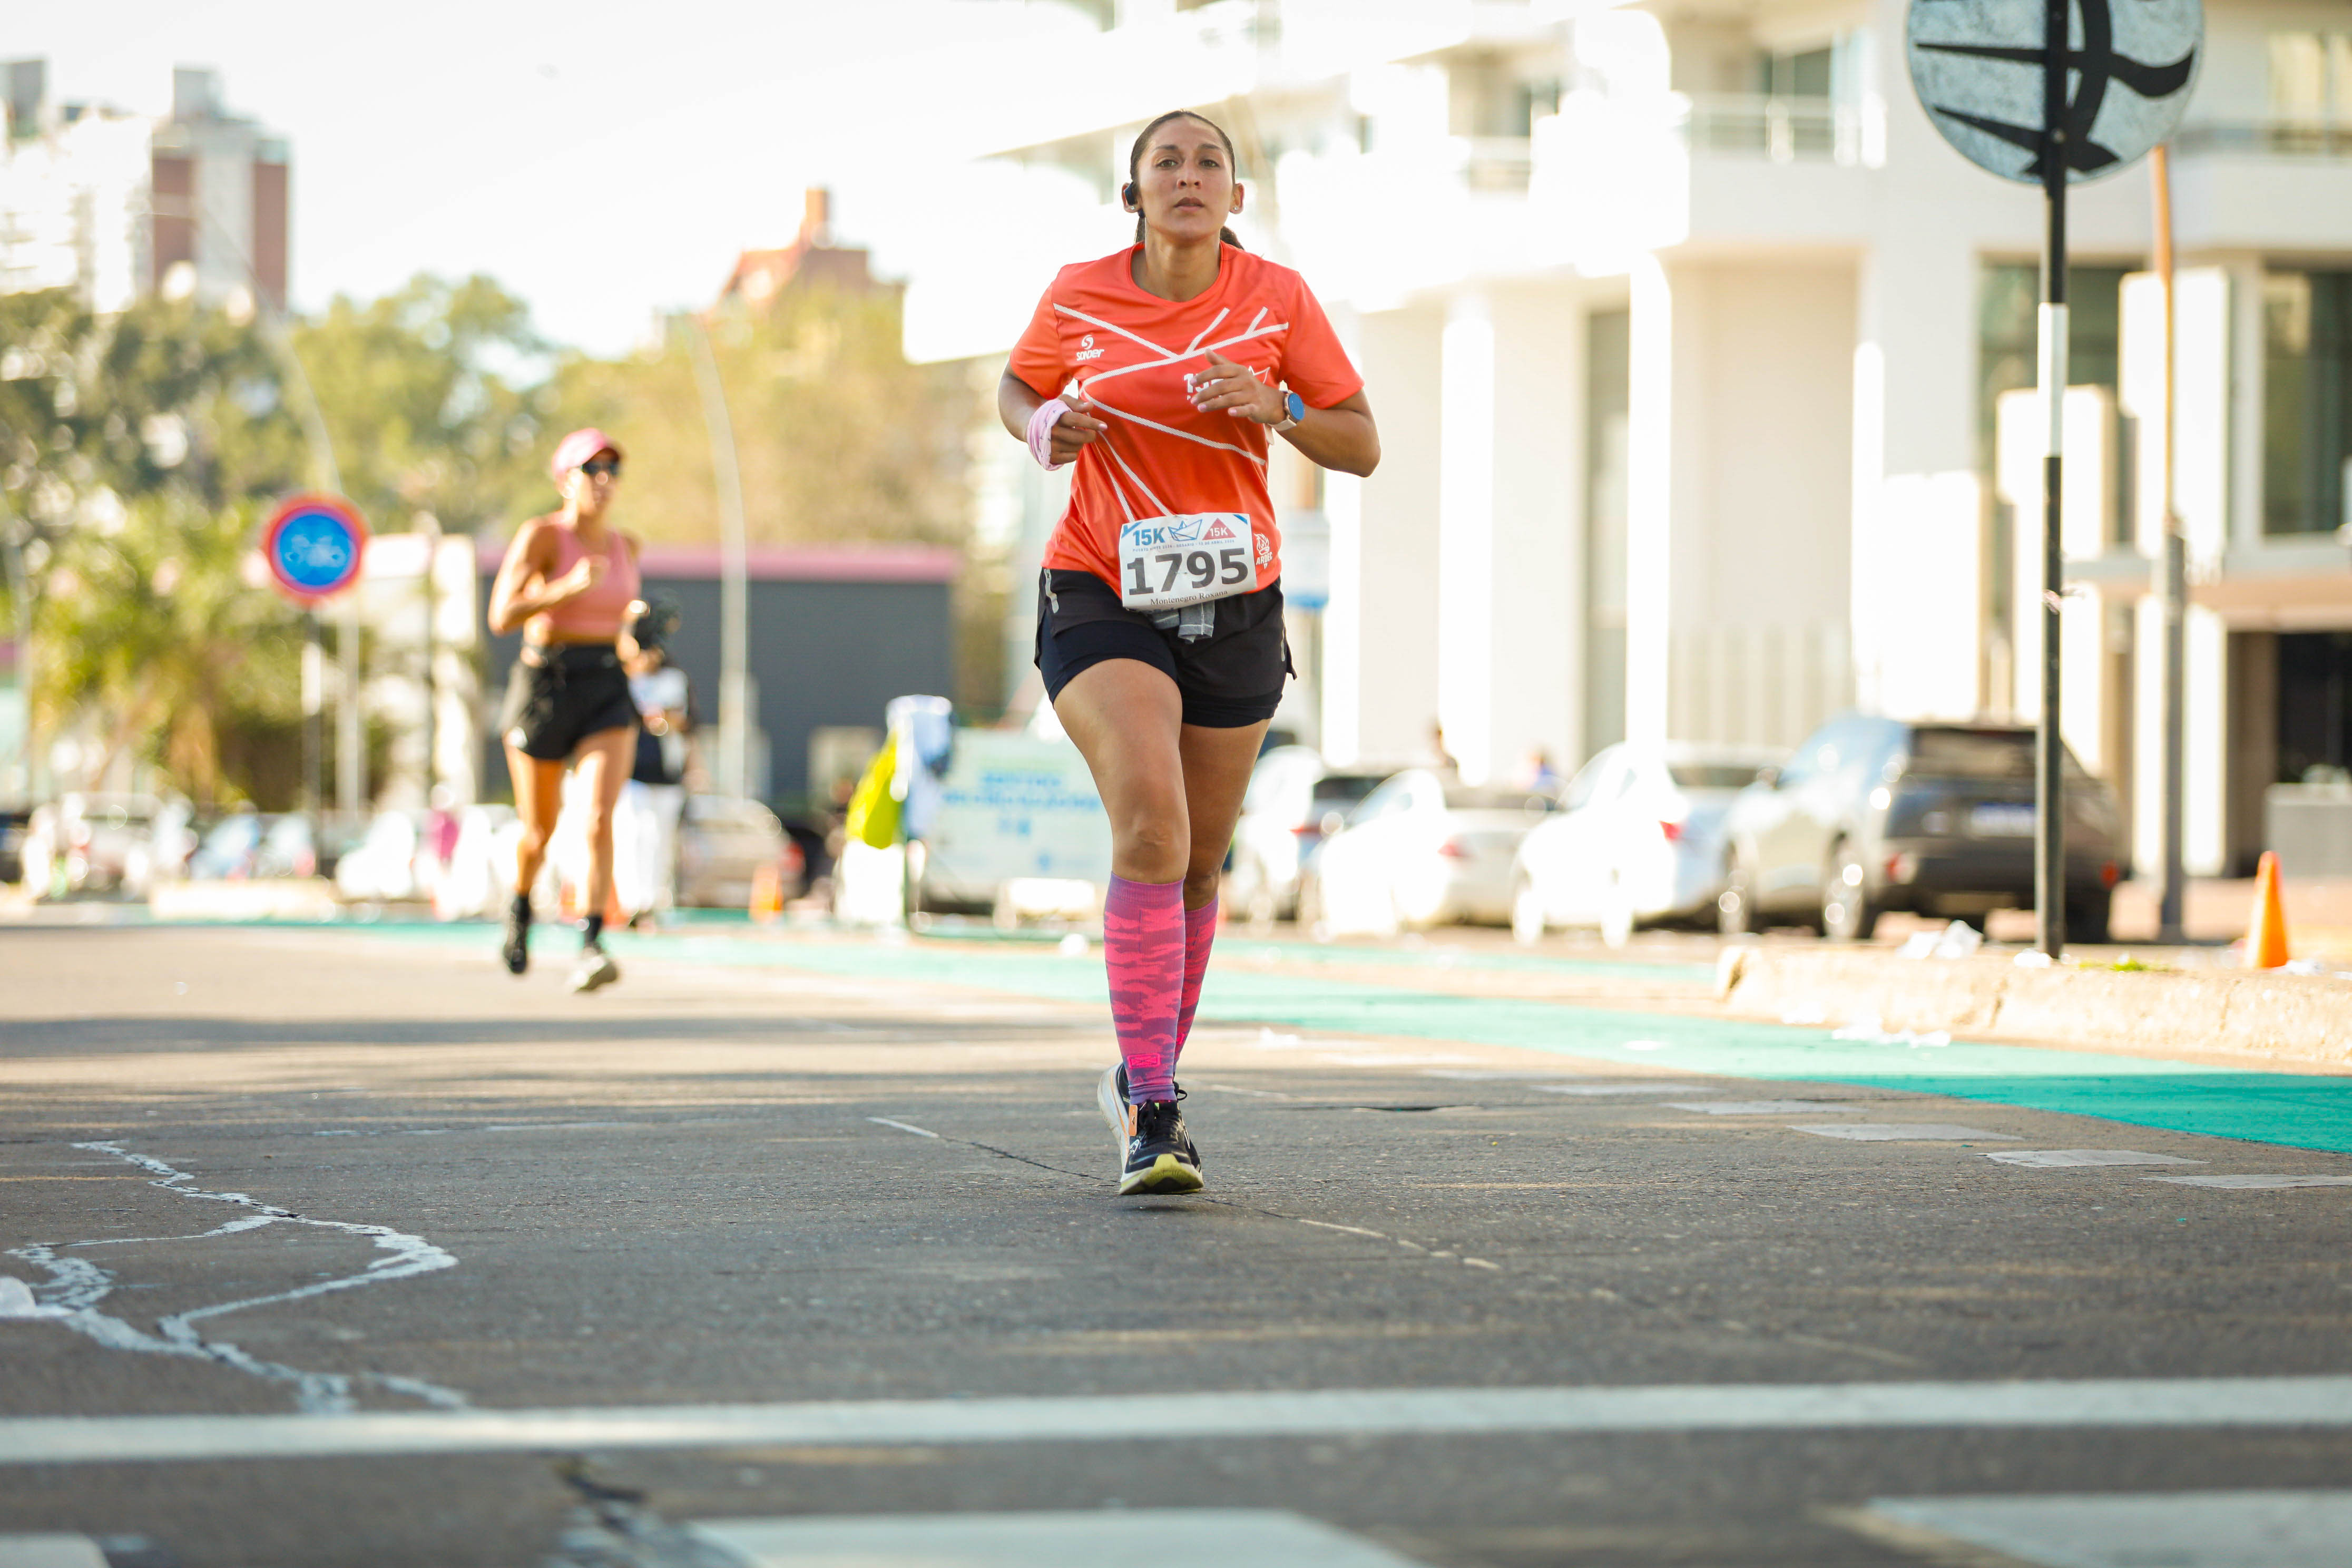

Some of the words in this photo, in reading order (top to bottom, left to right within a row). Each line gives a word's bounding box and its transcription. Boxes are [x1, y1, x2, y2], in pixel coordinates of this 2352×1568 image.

[1133, 527, 1165, 546] 15K
[1209, 527, 1228, 537] 15K
[1256, 552, 1273, 565] ARDEC
[1127, 547, 1248, 595] 1795
[1151, 595, 1197, 605] Montenegro
[1199, 590, 1228, 599] Roxana
